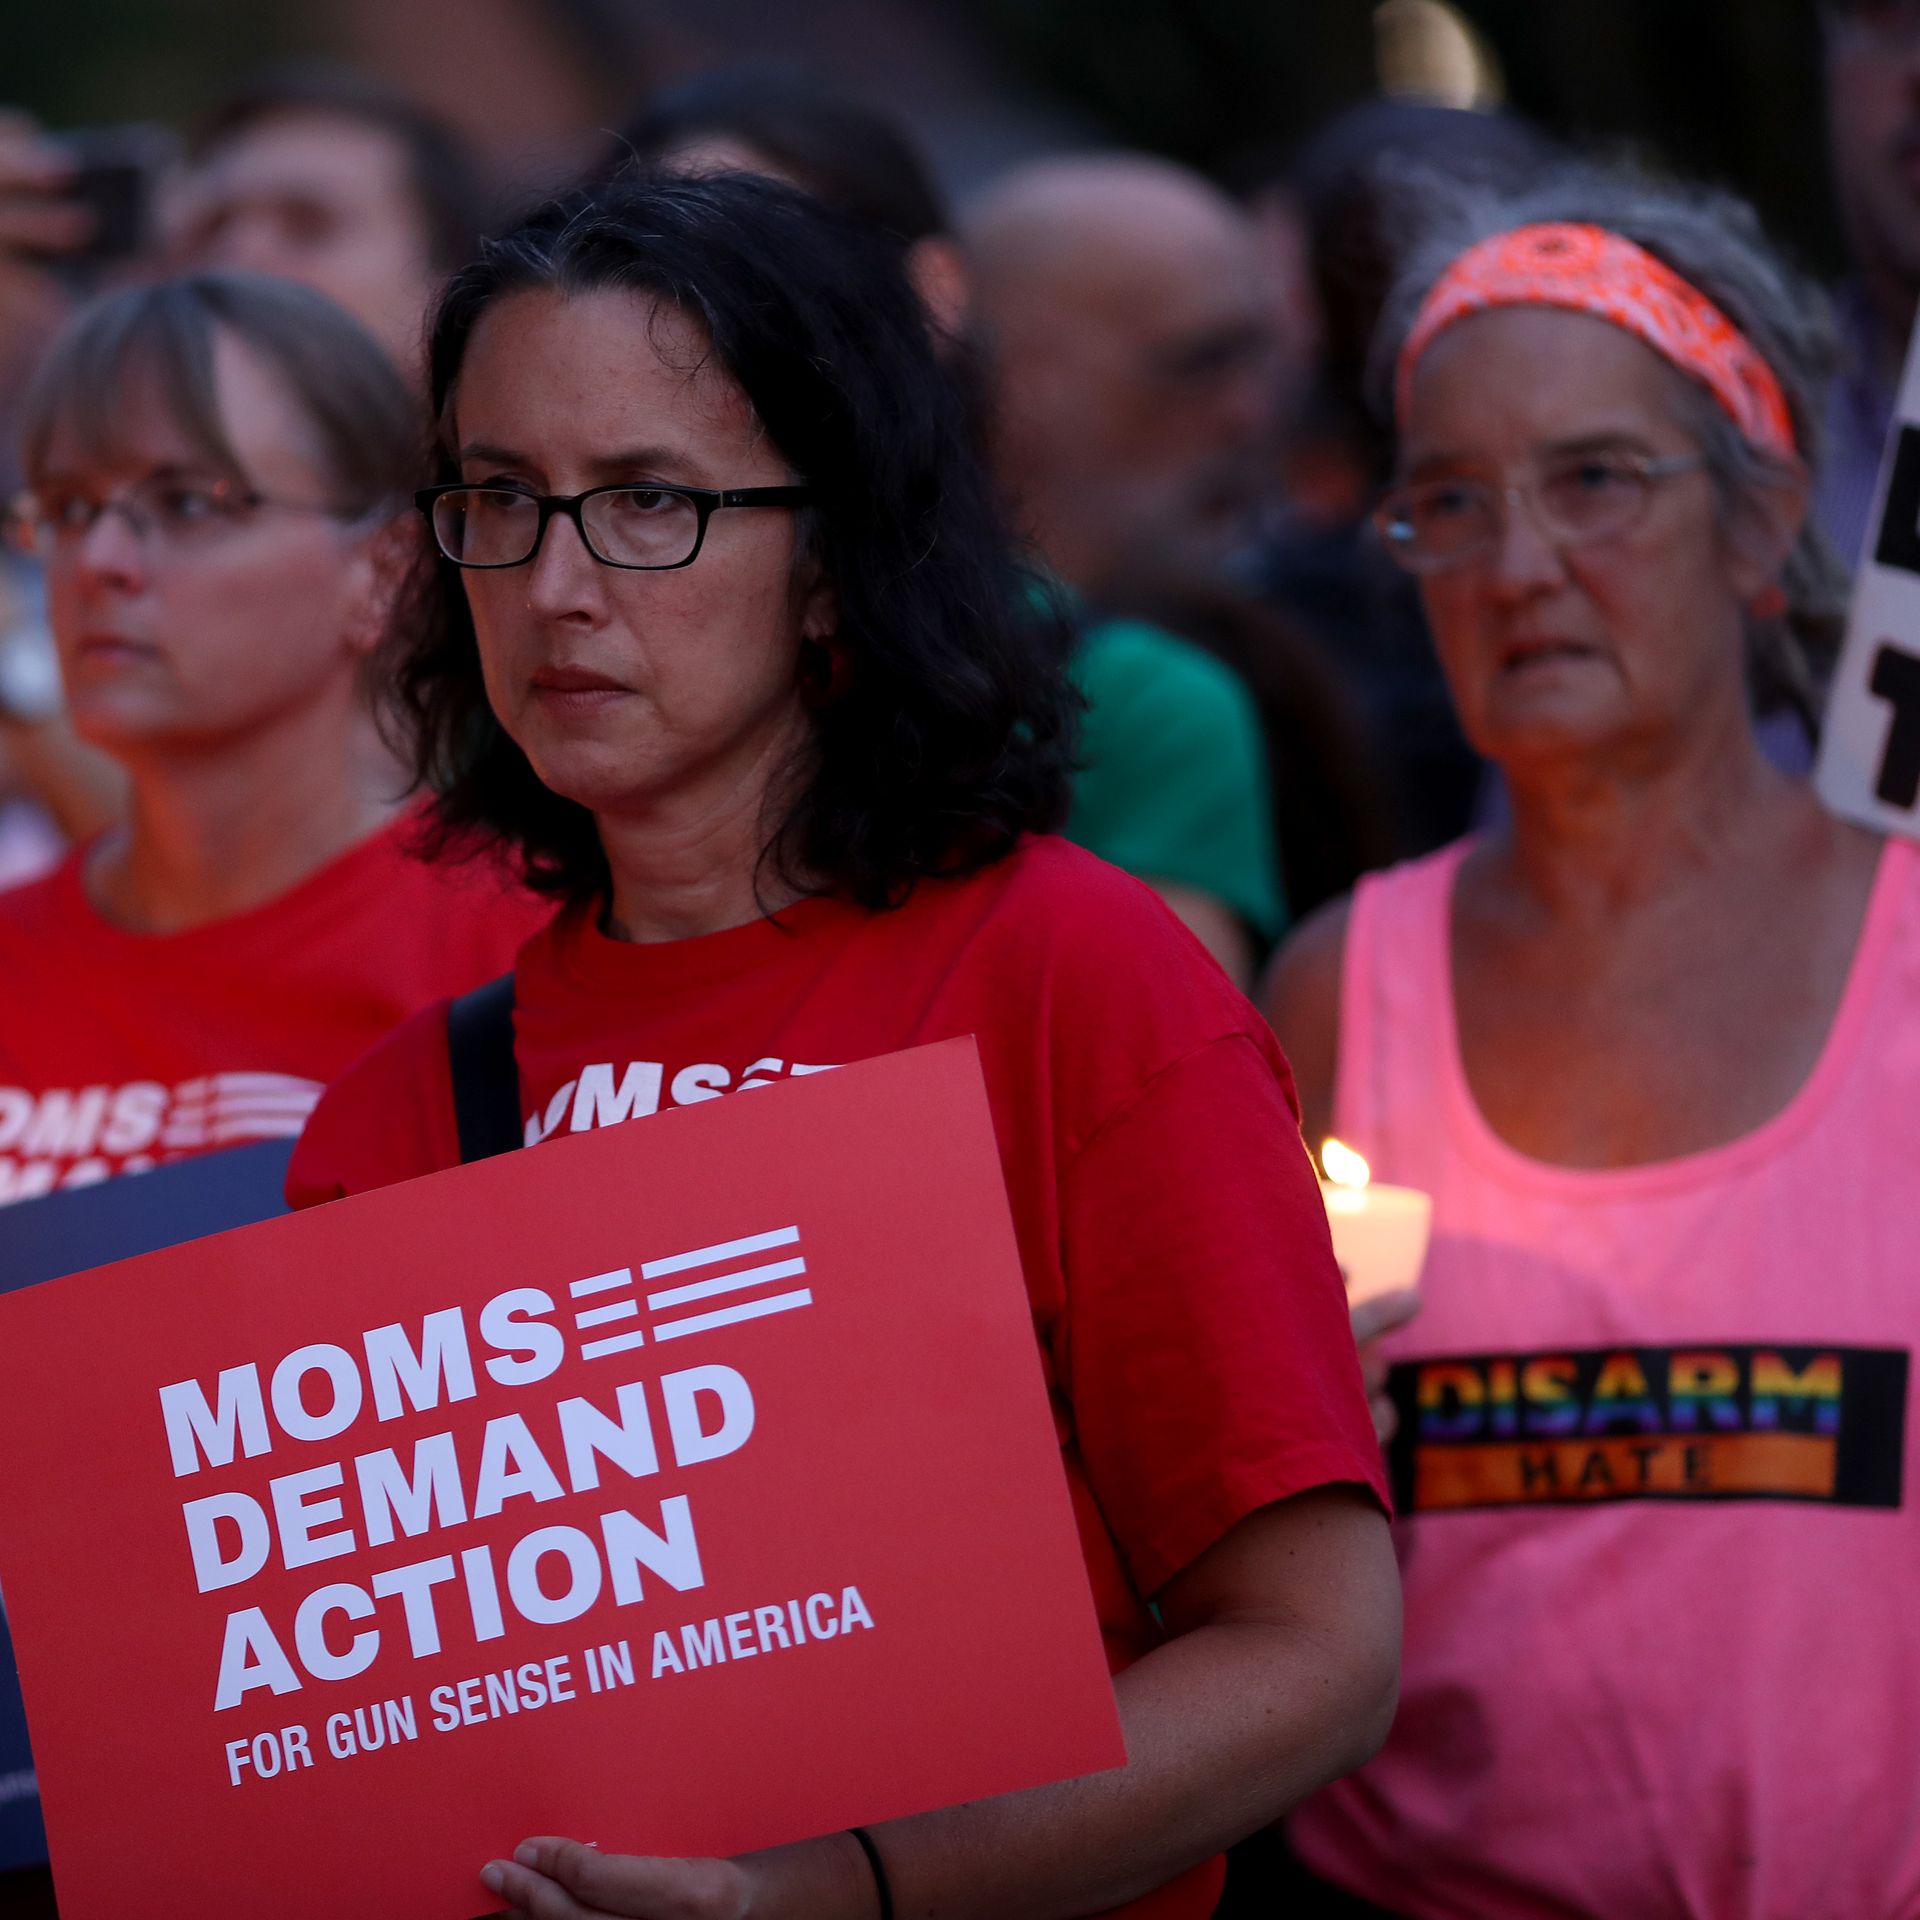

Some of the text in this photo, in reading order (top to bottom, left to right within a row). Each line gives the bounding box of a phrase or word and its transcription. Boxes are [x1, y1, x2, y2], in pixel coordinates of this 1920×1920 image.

[523, 1060, 732, 1149] MS
[159, 1287, 565, 1478] MOMS
[1416, 1348, 1844, 1440] DISARM
[1518, 1441, 1715, 1491] HATE
[182, 1364, 755, 1594] DEMAND
[213, 1494, 705, 1712] ACTION
[225, 1585, 875, 1786] FOR GUN SENSE IN AMERICA
